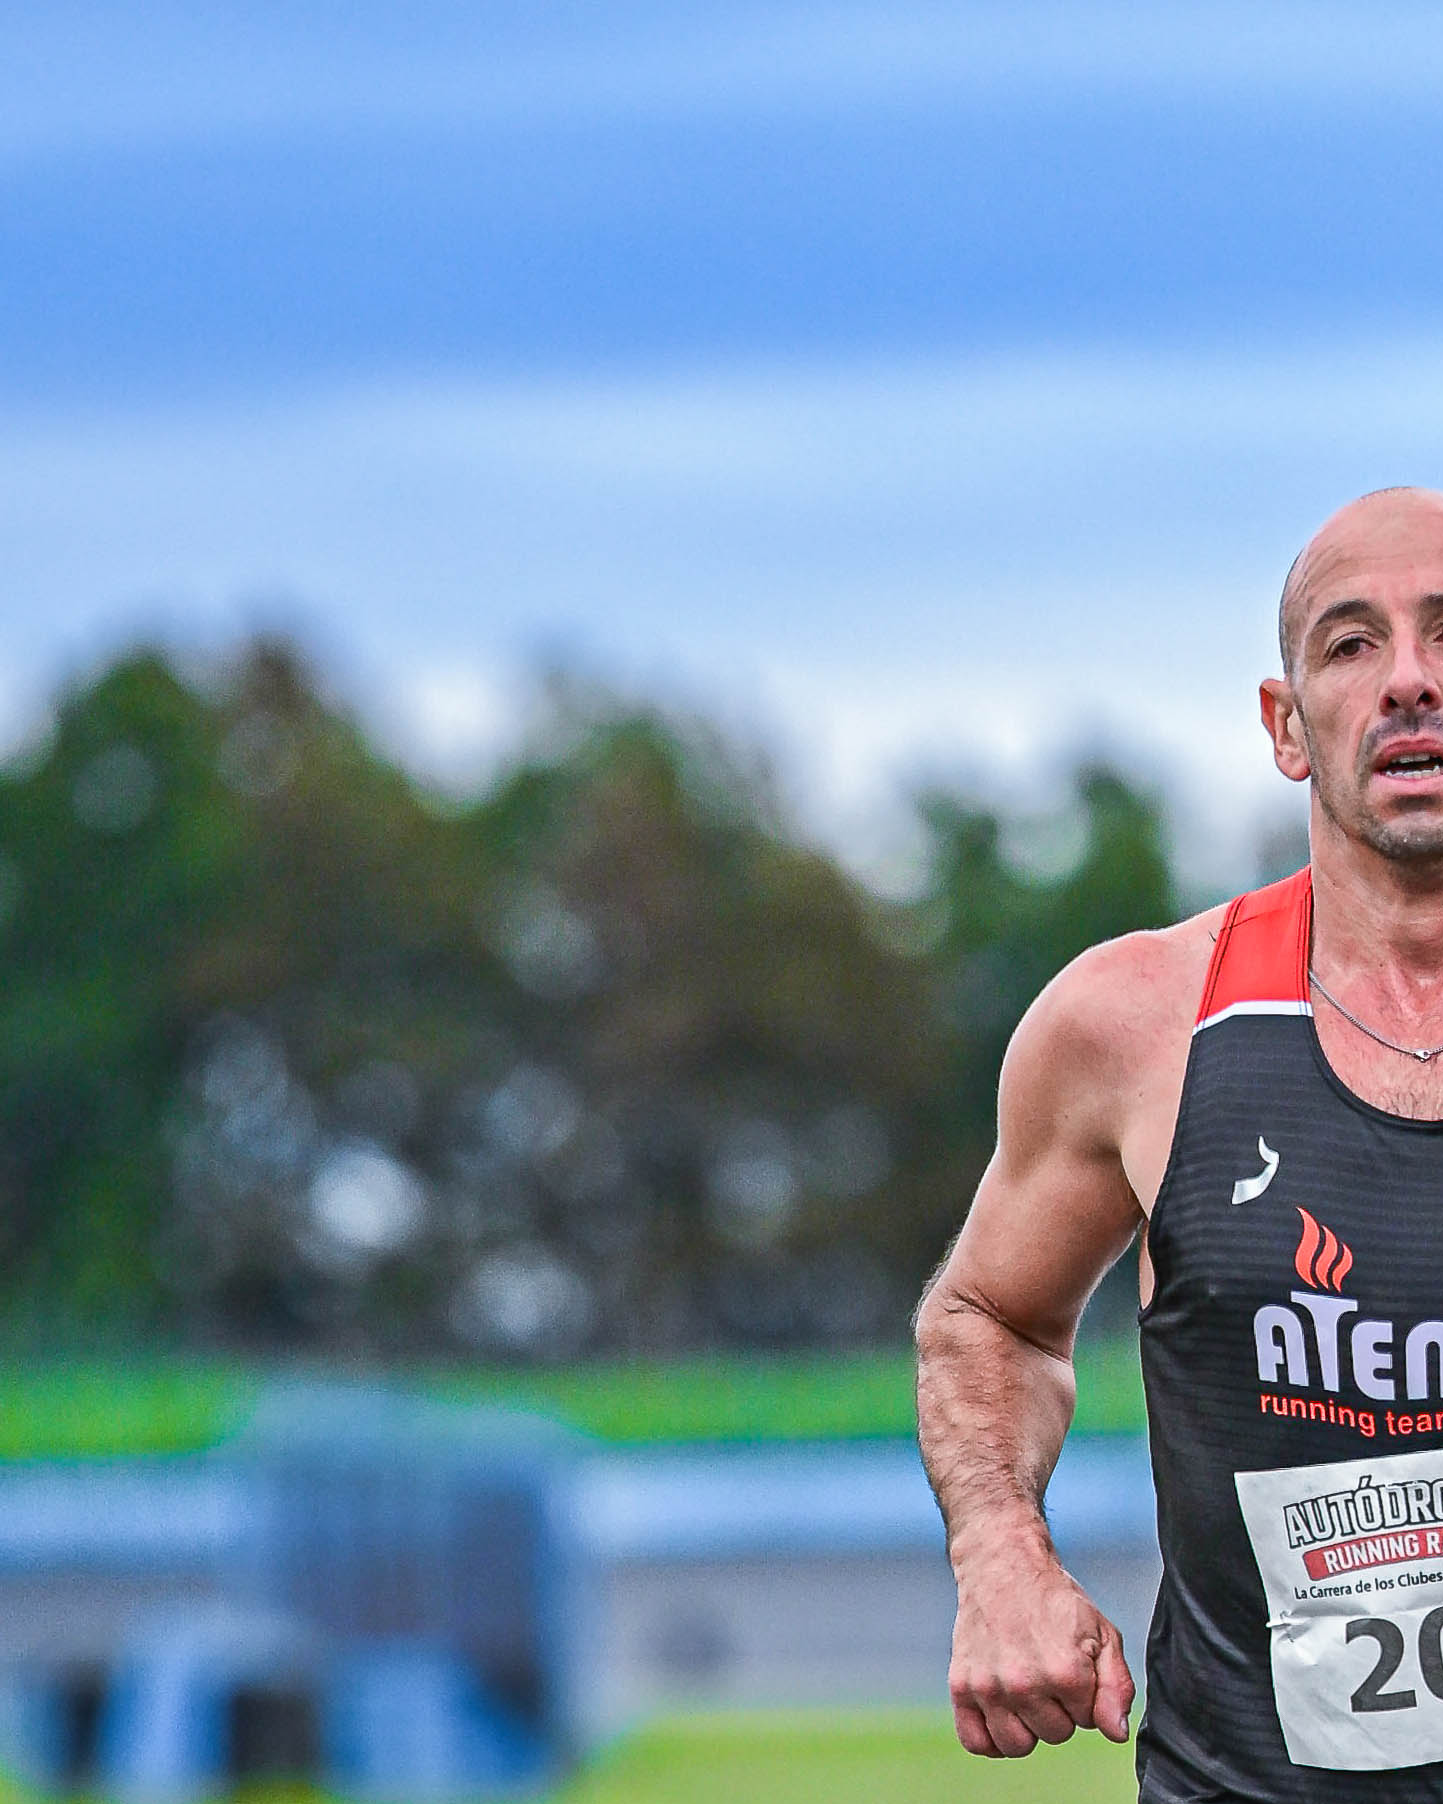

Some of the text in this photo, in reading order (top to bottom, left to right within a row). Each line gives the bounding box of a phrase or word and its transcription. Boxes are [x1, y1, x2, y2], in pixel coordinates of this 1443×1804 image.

[1260, 1393, 1375, 1438] running
[1323, 1532, 1420, 1574] RUNNING
[1294, 1587, 1308, 1600] La
[1310, 1584, 1352, 1599] Carrera
[1355, 1579, 1371, 1594] de
[1375, 1577, 1395, 1591] los
[1398, 1570, 1443, 1588] Clubes
